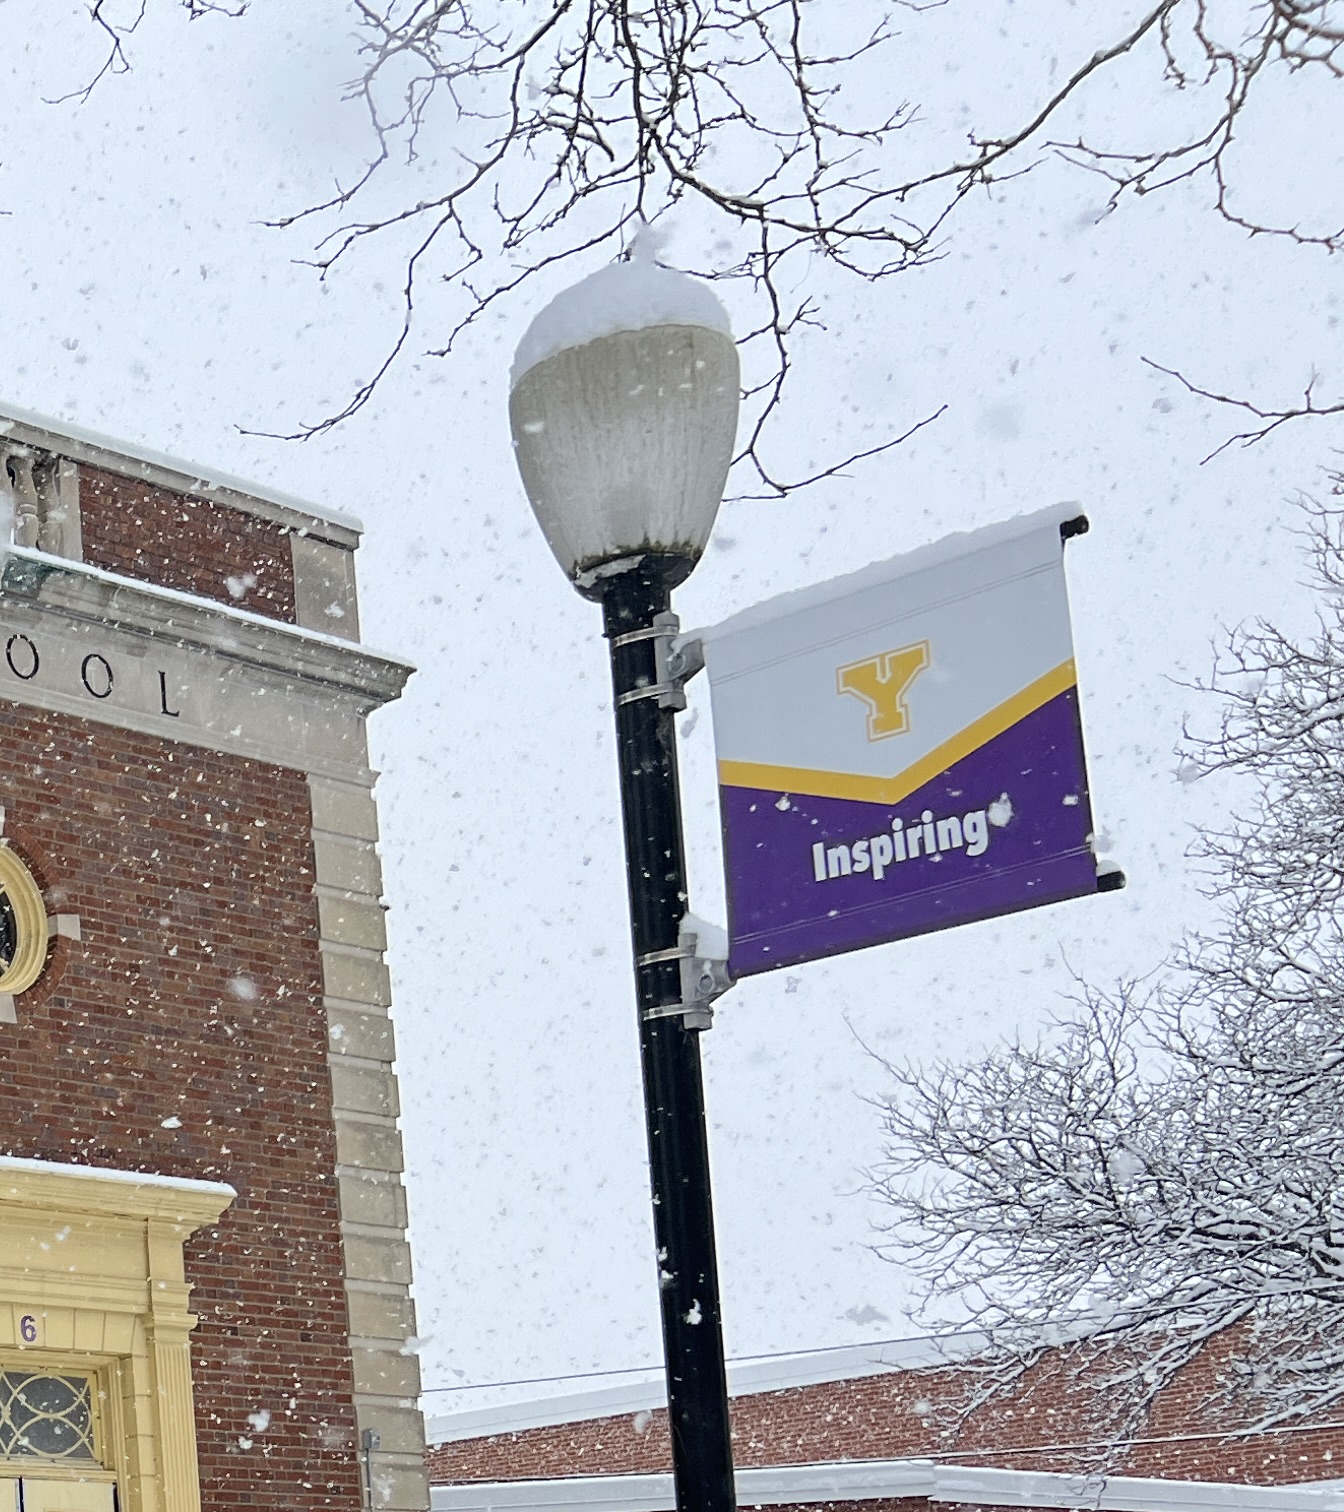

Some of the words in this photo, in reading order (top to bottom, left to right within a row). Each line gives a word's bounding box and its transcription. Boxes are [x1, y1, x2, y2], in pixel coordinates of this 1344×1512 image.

[835, 639, 931, 743] Y
[813, 810, 989, 882] Inspiring
[20, 1315, 37, 1342] 6
